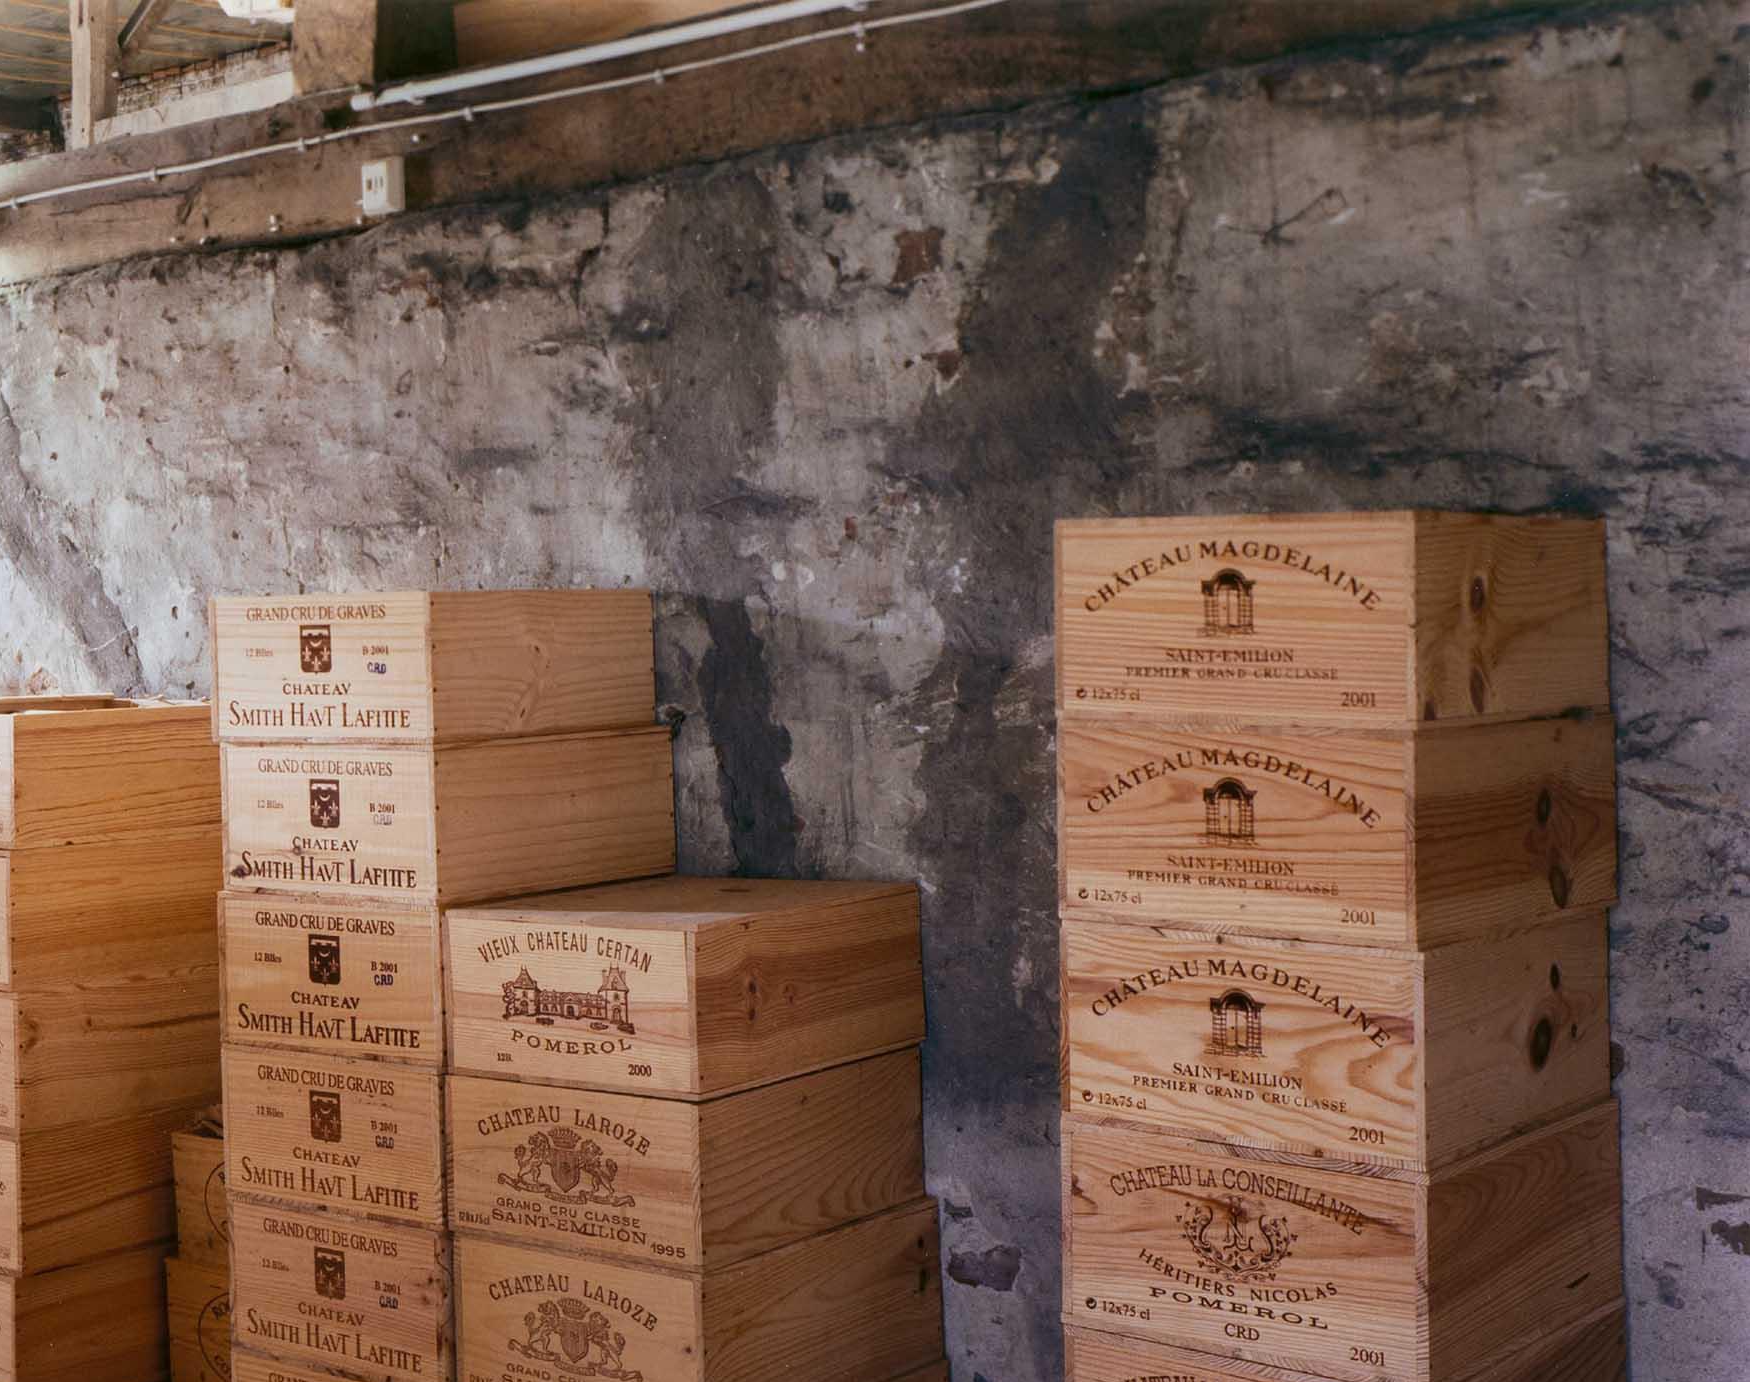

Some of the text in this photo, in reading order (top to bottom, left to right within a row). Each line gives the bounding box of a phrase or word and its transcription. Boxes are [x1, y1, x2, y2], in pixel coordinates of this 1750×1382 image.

[1199, 540, 1382, 611] MAGDELAINE
[246, 604, 386, 621] GRAND CRU DE GRAVES
[282, 683, 351, 695] CHATEAV
[1341, 691, 1377, 707] 2001
[230, 701, 410, 728] SMITH HAVT LAFITTE
[258, 759, 392, 776] GRAND CRU DE GRAVES
[1200, 749, 1382, 829] MAGDELAINE
[292, 837, 358, 852] CHATEAV
[242, 851, 417, 888] SMITH HAVT LAFITTE
[300, 914, 395, 936] CRU DE GRAVES
[1341, 909, 1376, 925] 2001
[478, 931, 651, 974] VIEUX CHATEAU CERTAN
[291, 991, 360, 1009] CHATEAV
[1206, 959, 1391, 1049] MAGDELAINE
[238, 1003, 420, 1048] SMITH HAVT LAFITTE
[510, 1028, 632, 1054] POMEROL
[628, 1064, 651, 1077] 2000
[1173, 1062, 1302, 1089] SAINT-EMILION
[328, 1074, 394, 1096] DE GRAVES
[1133, 1075, 1198, 1093] PREMIER
[478, 1105, 650, 1156] CHATEAU LAROZE
[1349, 1126, 1386, 1144] 2001
[241, 1156, 419, 1211] SMITH HAVT LAFITTE
[496, 1197, 641, 1227] GRAND CRU CLASSE
[1196, 1167, 1364, 1236] LA CONSEILLANTE
[492, 1208, 647, 1245] SAINT-EMILION
[651, 1242, 686, 1258] 1995
[488, 1272, 658, 1332] CHATEAU LAROZE
[1250, 1282, 1338, 1304] NICOLAS
[1149, 1286, 1329, 1329] POMEROL
[248, 1308, 300, 1344] SMITH
[356, 1333, 422, 1373] LAFITTE
[1224, 1323, 1260, 1341] CRD
[1349, 1347, 1385, 1367] 2001
